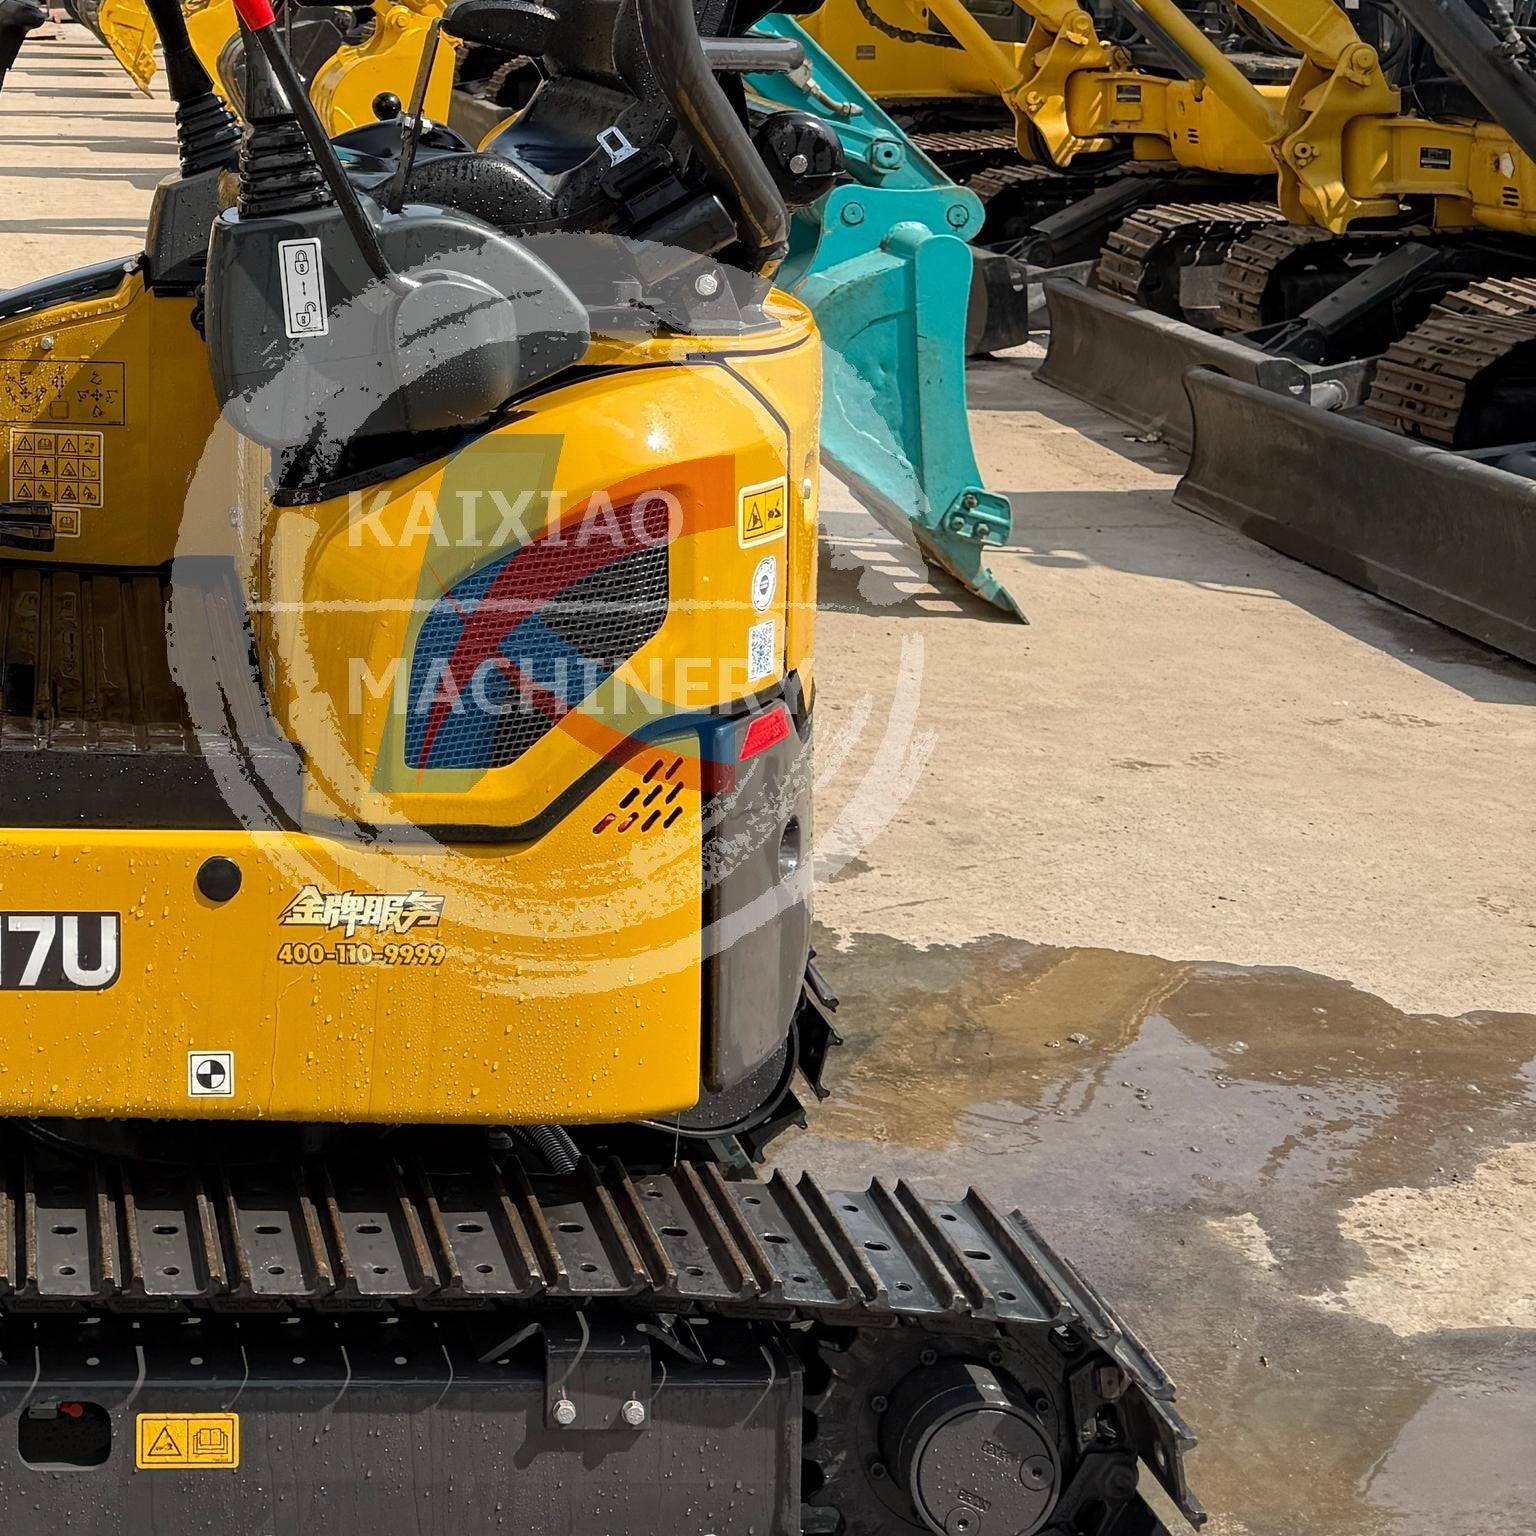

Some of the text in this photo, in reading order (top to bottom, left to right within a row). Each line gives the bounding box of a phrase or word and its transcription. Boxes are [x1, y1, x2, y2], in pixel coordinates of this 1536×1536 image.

[277, 884, 446, 940] 金牌服务
[277, 942, 447, 965] 400-110-9999
